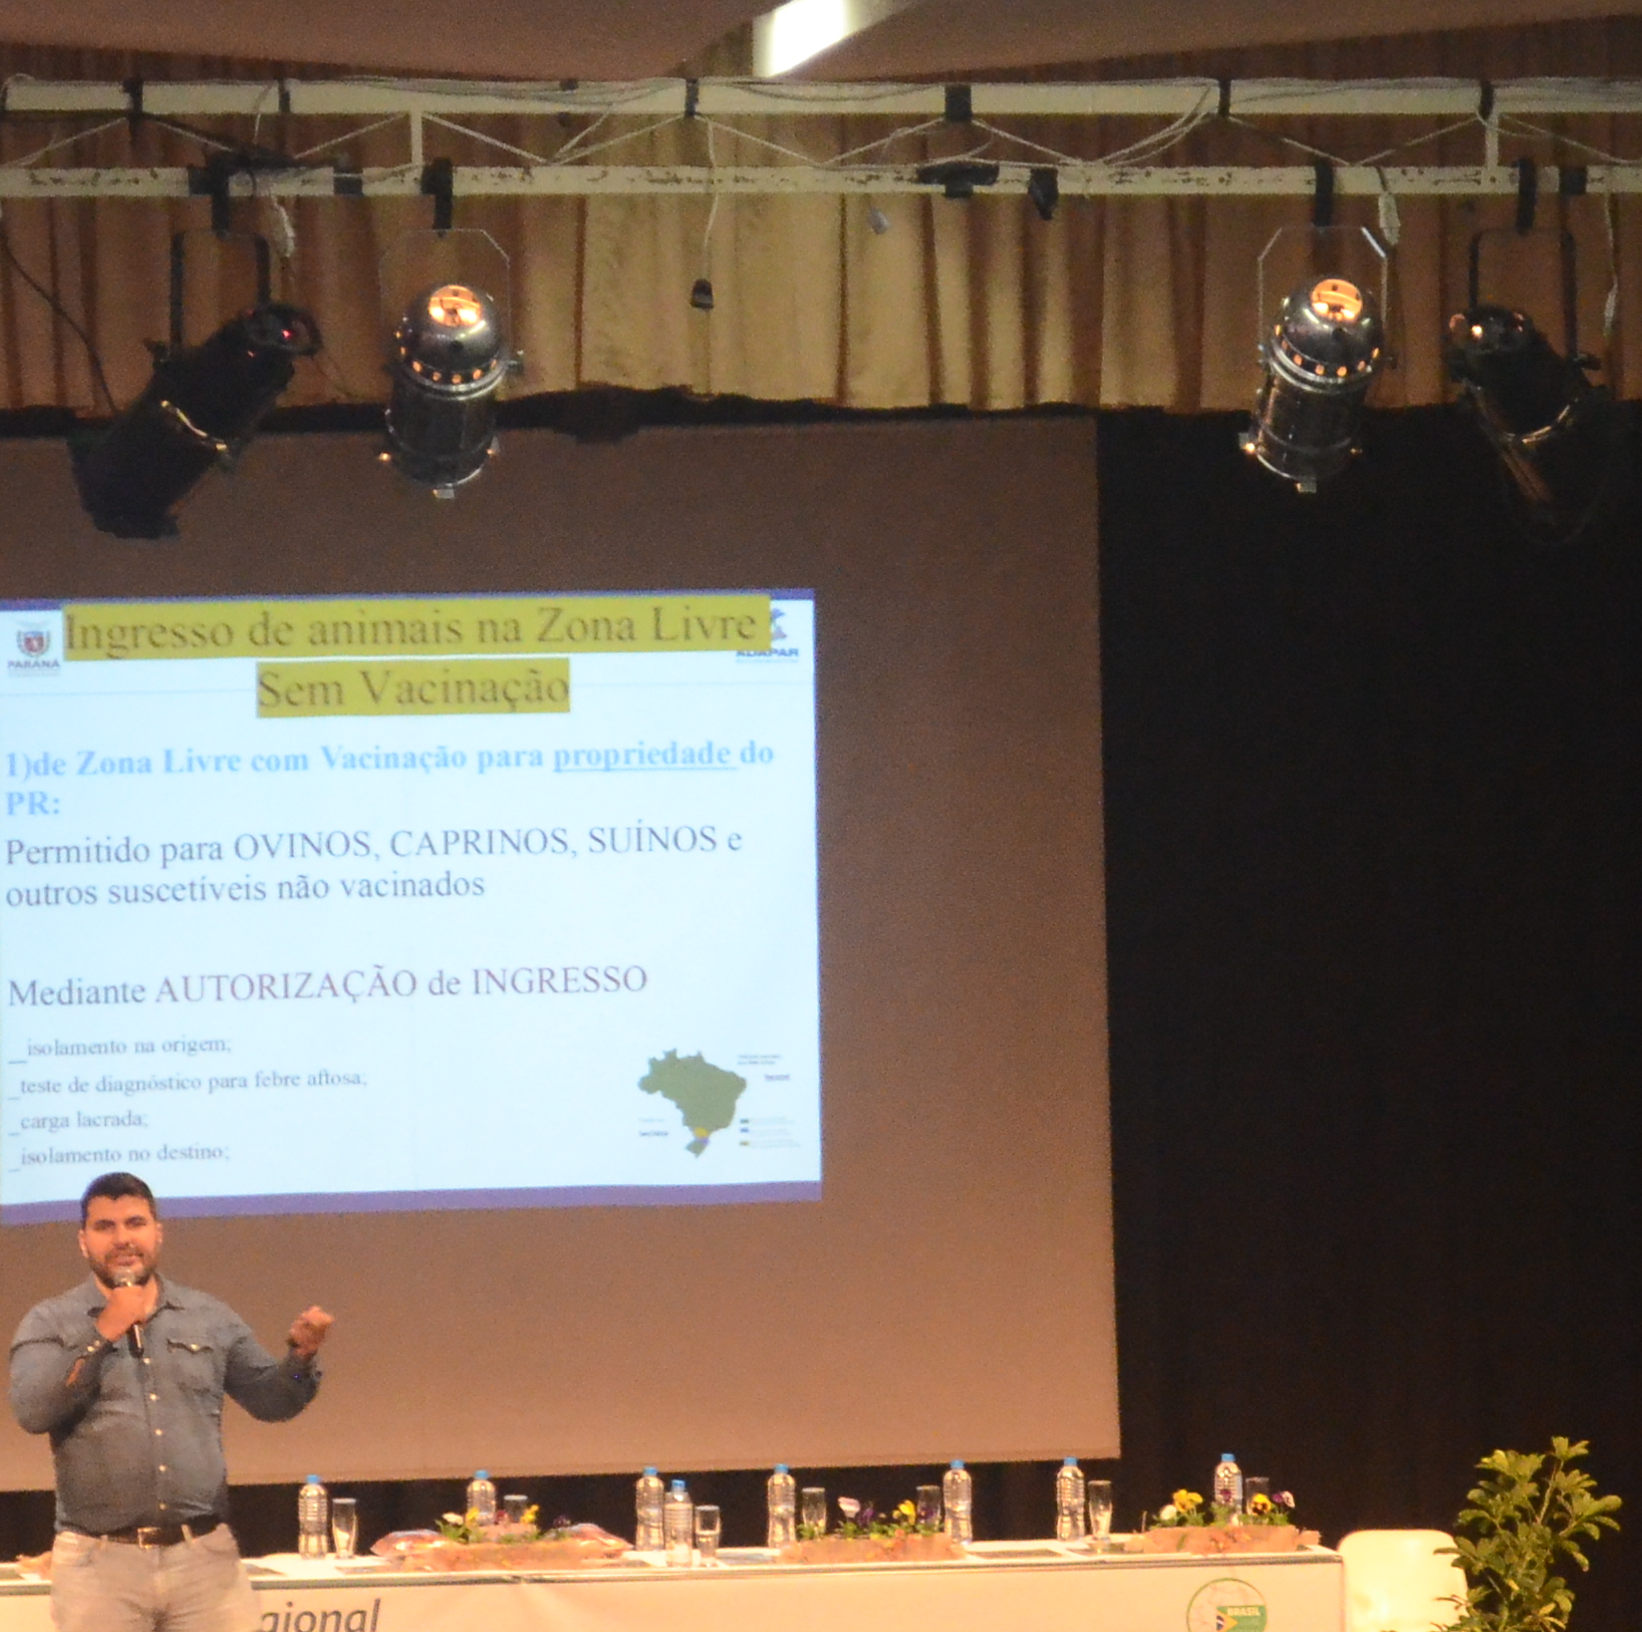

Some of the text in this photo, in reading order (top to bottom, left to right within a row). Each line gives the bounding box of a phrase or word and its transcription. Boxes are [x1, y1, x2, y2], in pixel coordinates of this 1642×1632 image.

[66, 604, 758, 660] Ingresso de animais na Zona Livre
[258, 667, 570, 712] Sem Vacinação
[6, 740, 775, 782] 1)de Zona Livre com Vacinação para propriedade do
[6, 791, 60, 817] PR:
[6, 818, 743, 870] Permitido para OVINOS, CAPRINOS, SUÍNOS e
[6, 871, 486, 907] outros suscetíveis não vacinados
[8, 964, 649, 1007] Mediante AUTORIZAÇÃO de INGRESSO
[134, 1041, 156, 1055] na
[68, 1075, 90, 1094] de
[95, 1072, 202, 1097] diagnóstico
[207, 1074, 248, 1094] para
[254, 1069, 301, 1089] febre
[127, 1148, 151, 1163] no
[1226, 1606, 1261, 1617] BRASIL
